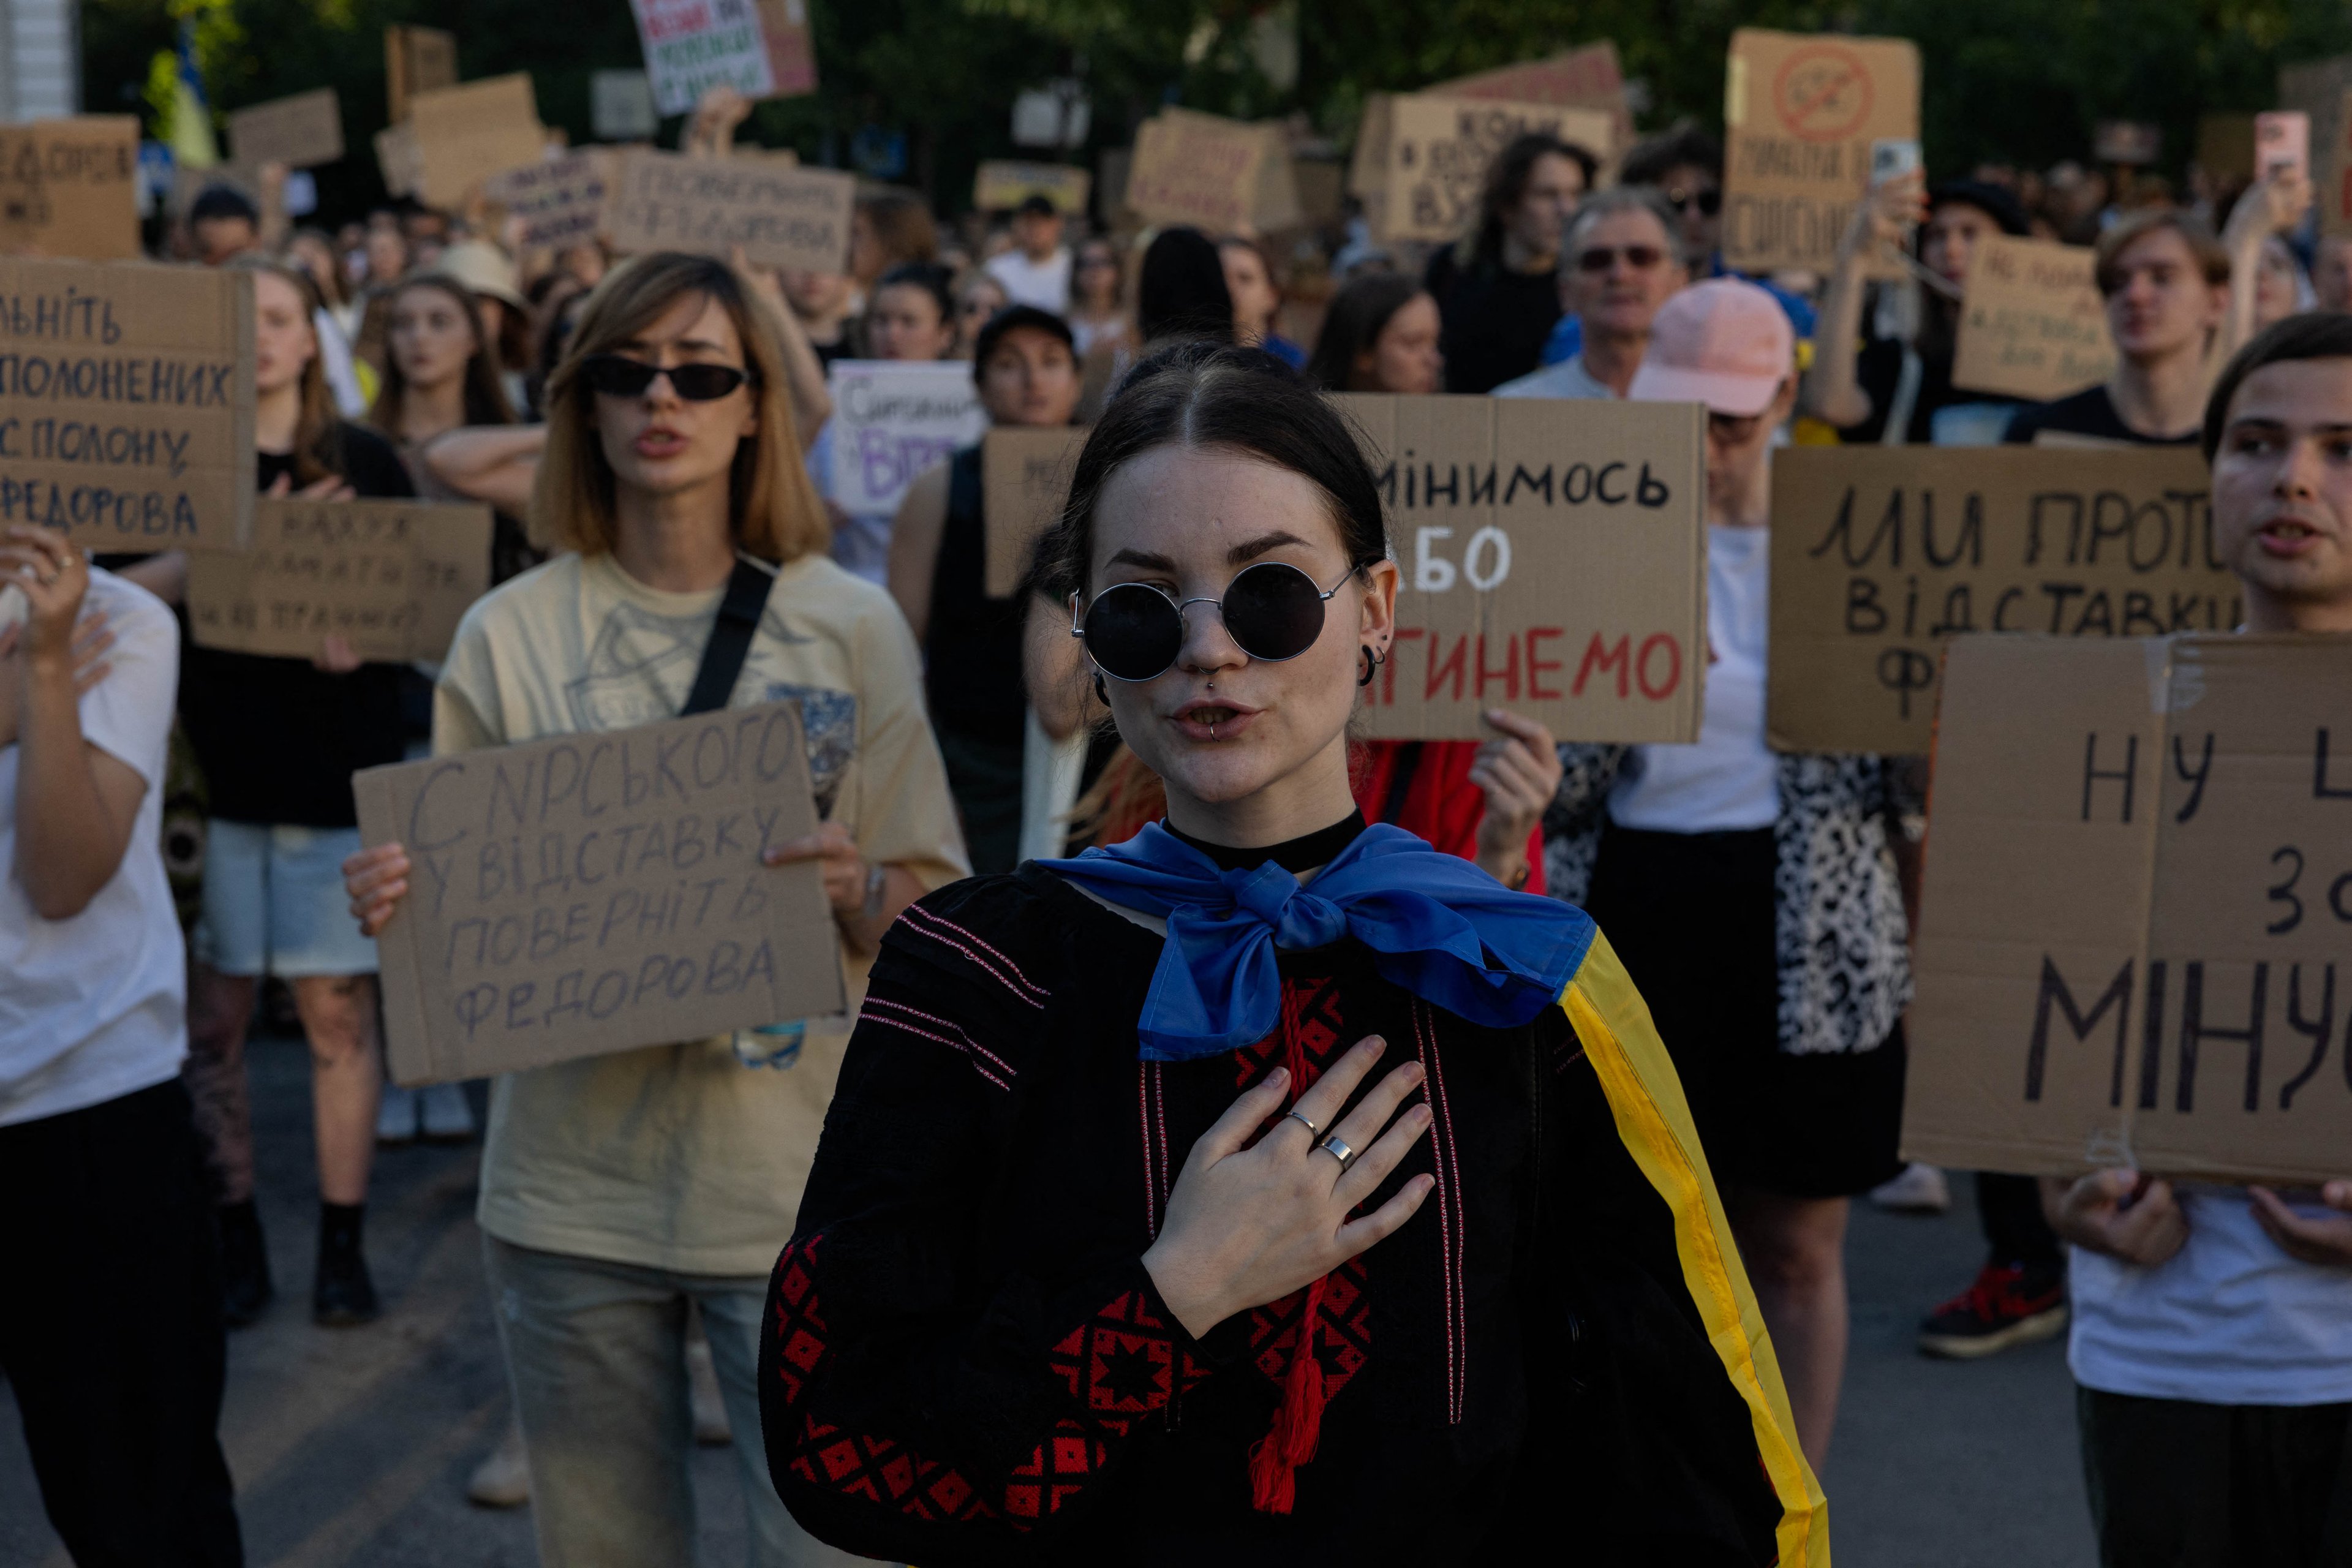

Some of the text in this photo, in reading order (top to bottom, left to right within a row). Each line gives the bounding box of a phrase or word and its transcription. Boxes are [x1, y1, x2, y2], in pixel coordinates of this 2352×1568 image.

[1385, 524, 1512, 593] БО
[1809, 486, 1984, 570] МИ
[1361, 626, 1682, 707] ГИНЕМО
[2081, 730, 2215, 824] НУ
[2024, 953, 2352, 1114] МІНУ
